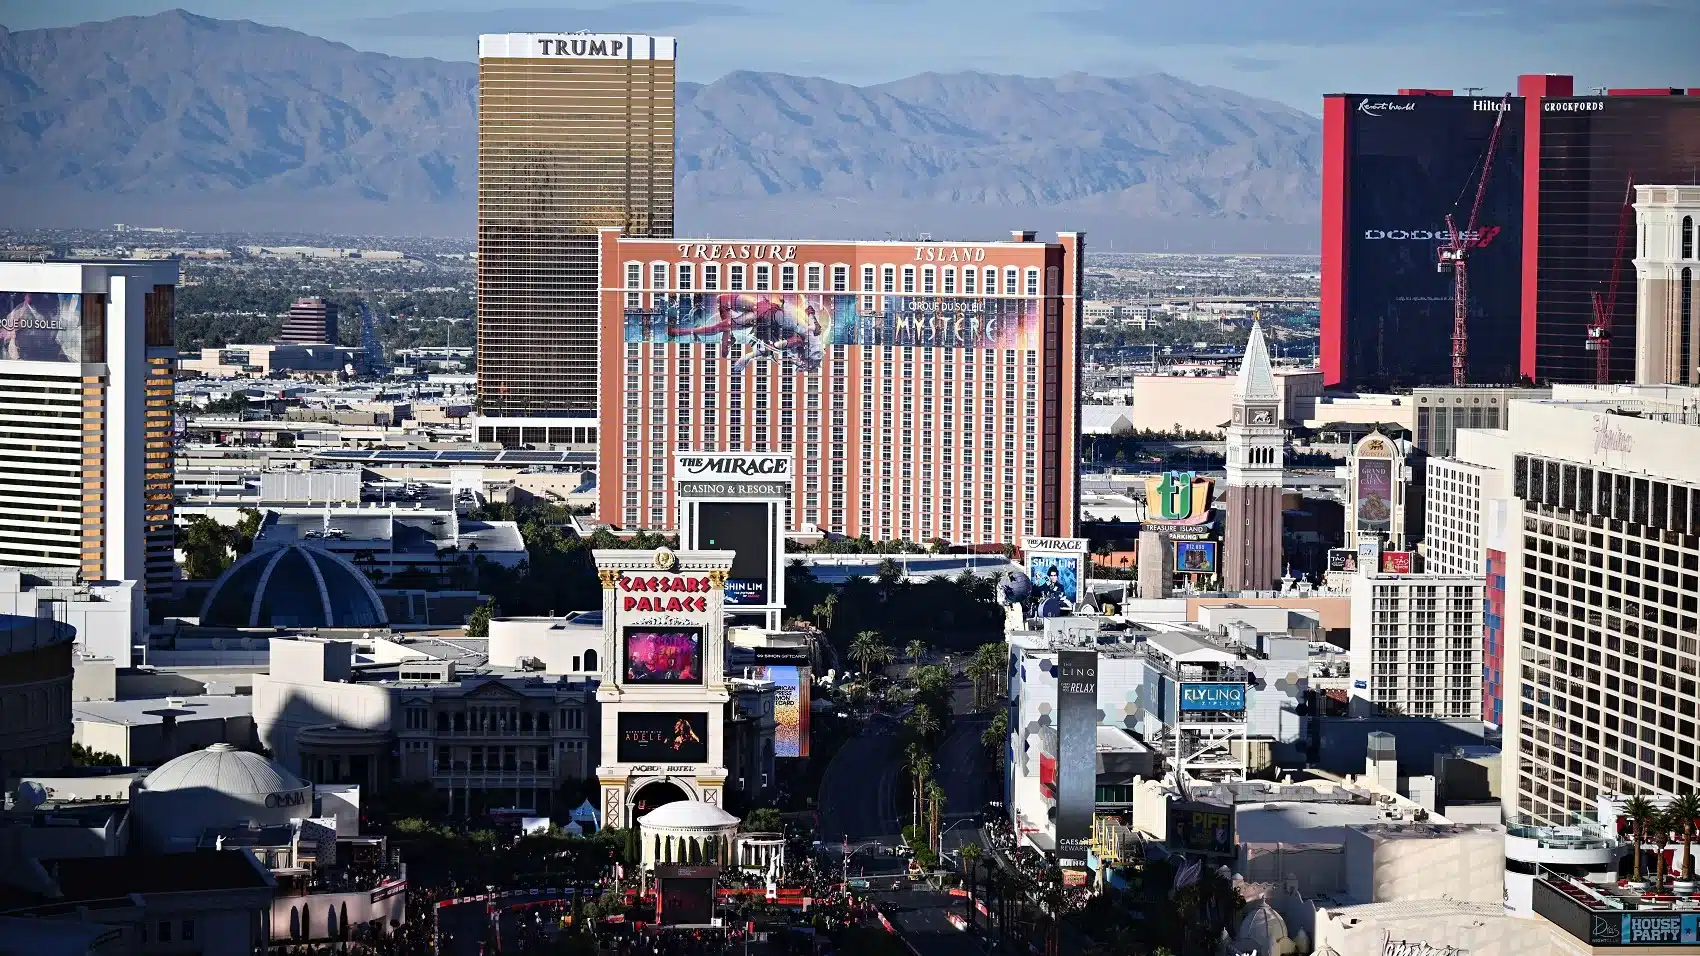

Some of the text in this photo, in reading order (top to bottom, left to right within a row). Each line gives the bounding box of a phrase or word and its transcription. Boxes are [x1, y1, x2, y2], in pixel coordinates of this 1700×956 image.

[538, 39, 624, 57] TRUMP
[1473, 100, 1511, 111] Hilton
[1544, 102, 1604, 112] CROCKFORDS
[1365, 229, 1480, 241] DODGE
[677, 243, 986, 262] TREASURE ISLAND
[942, 302, 953, 311] DU
[956, 302, 984, 312] SOLEIL
[0, 318, 64, 330] QUE DU SOLEIL
[680, 458, 788, 476] THE MIRAGE
[683, 484, 783, 494] CASINO & RESORT
[1156, 472, 1191, 520] ti
[1146, 524, 1177, 532] TREASURE
[1029, 540, 1081, 550] MIRAGE
[1033, 558, 1076, 569] SHIN LIM
[618, 576, 712, 592] CAESARS
[724, 582, 746, 590] SHIN
[623, 596, 708, 612] PALACE
[1062, 668, 1095, 677] LINQ
[1070, 682, 1095, 693] RELAX
[1184, 689, 1241, 702] FLYLINQ
[625, 733, 662, 741] ADELE
[264, 791, 306, 809] OMNIA
[1192, 811, 1229, 829] PIFF
[1631, 918, 1681, 930] HOUSE
[1632, 929, 1680, 941] PARTY
